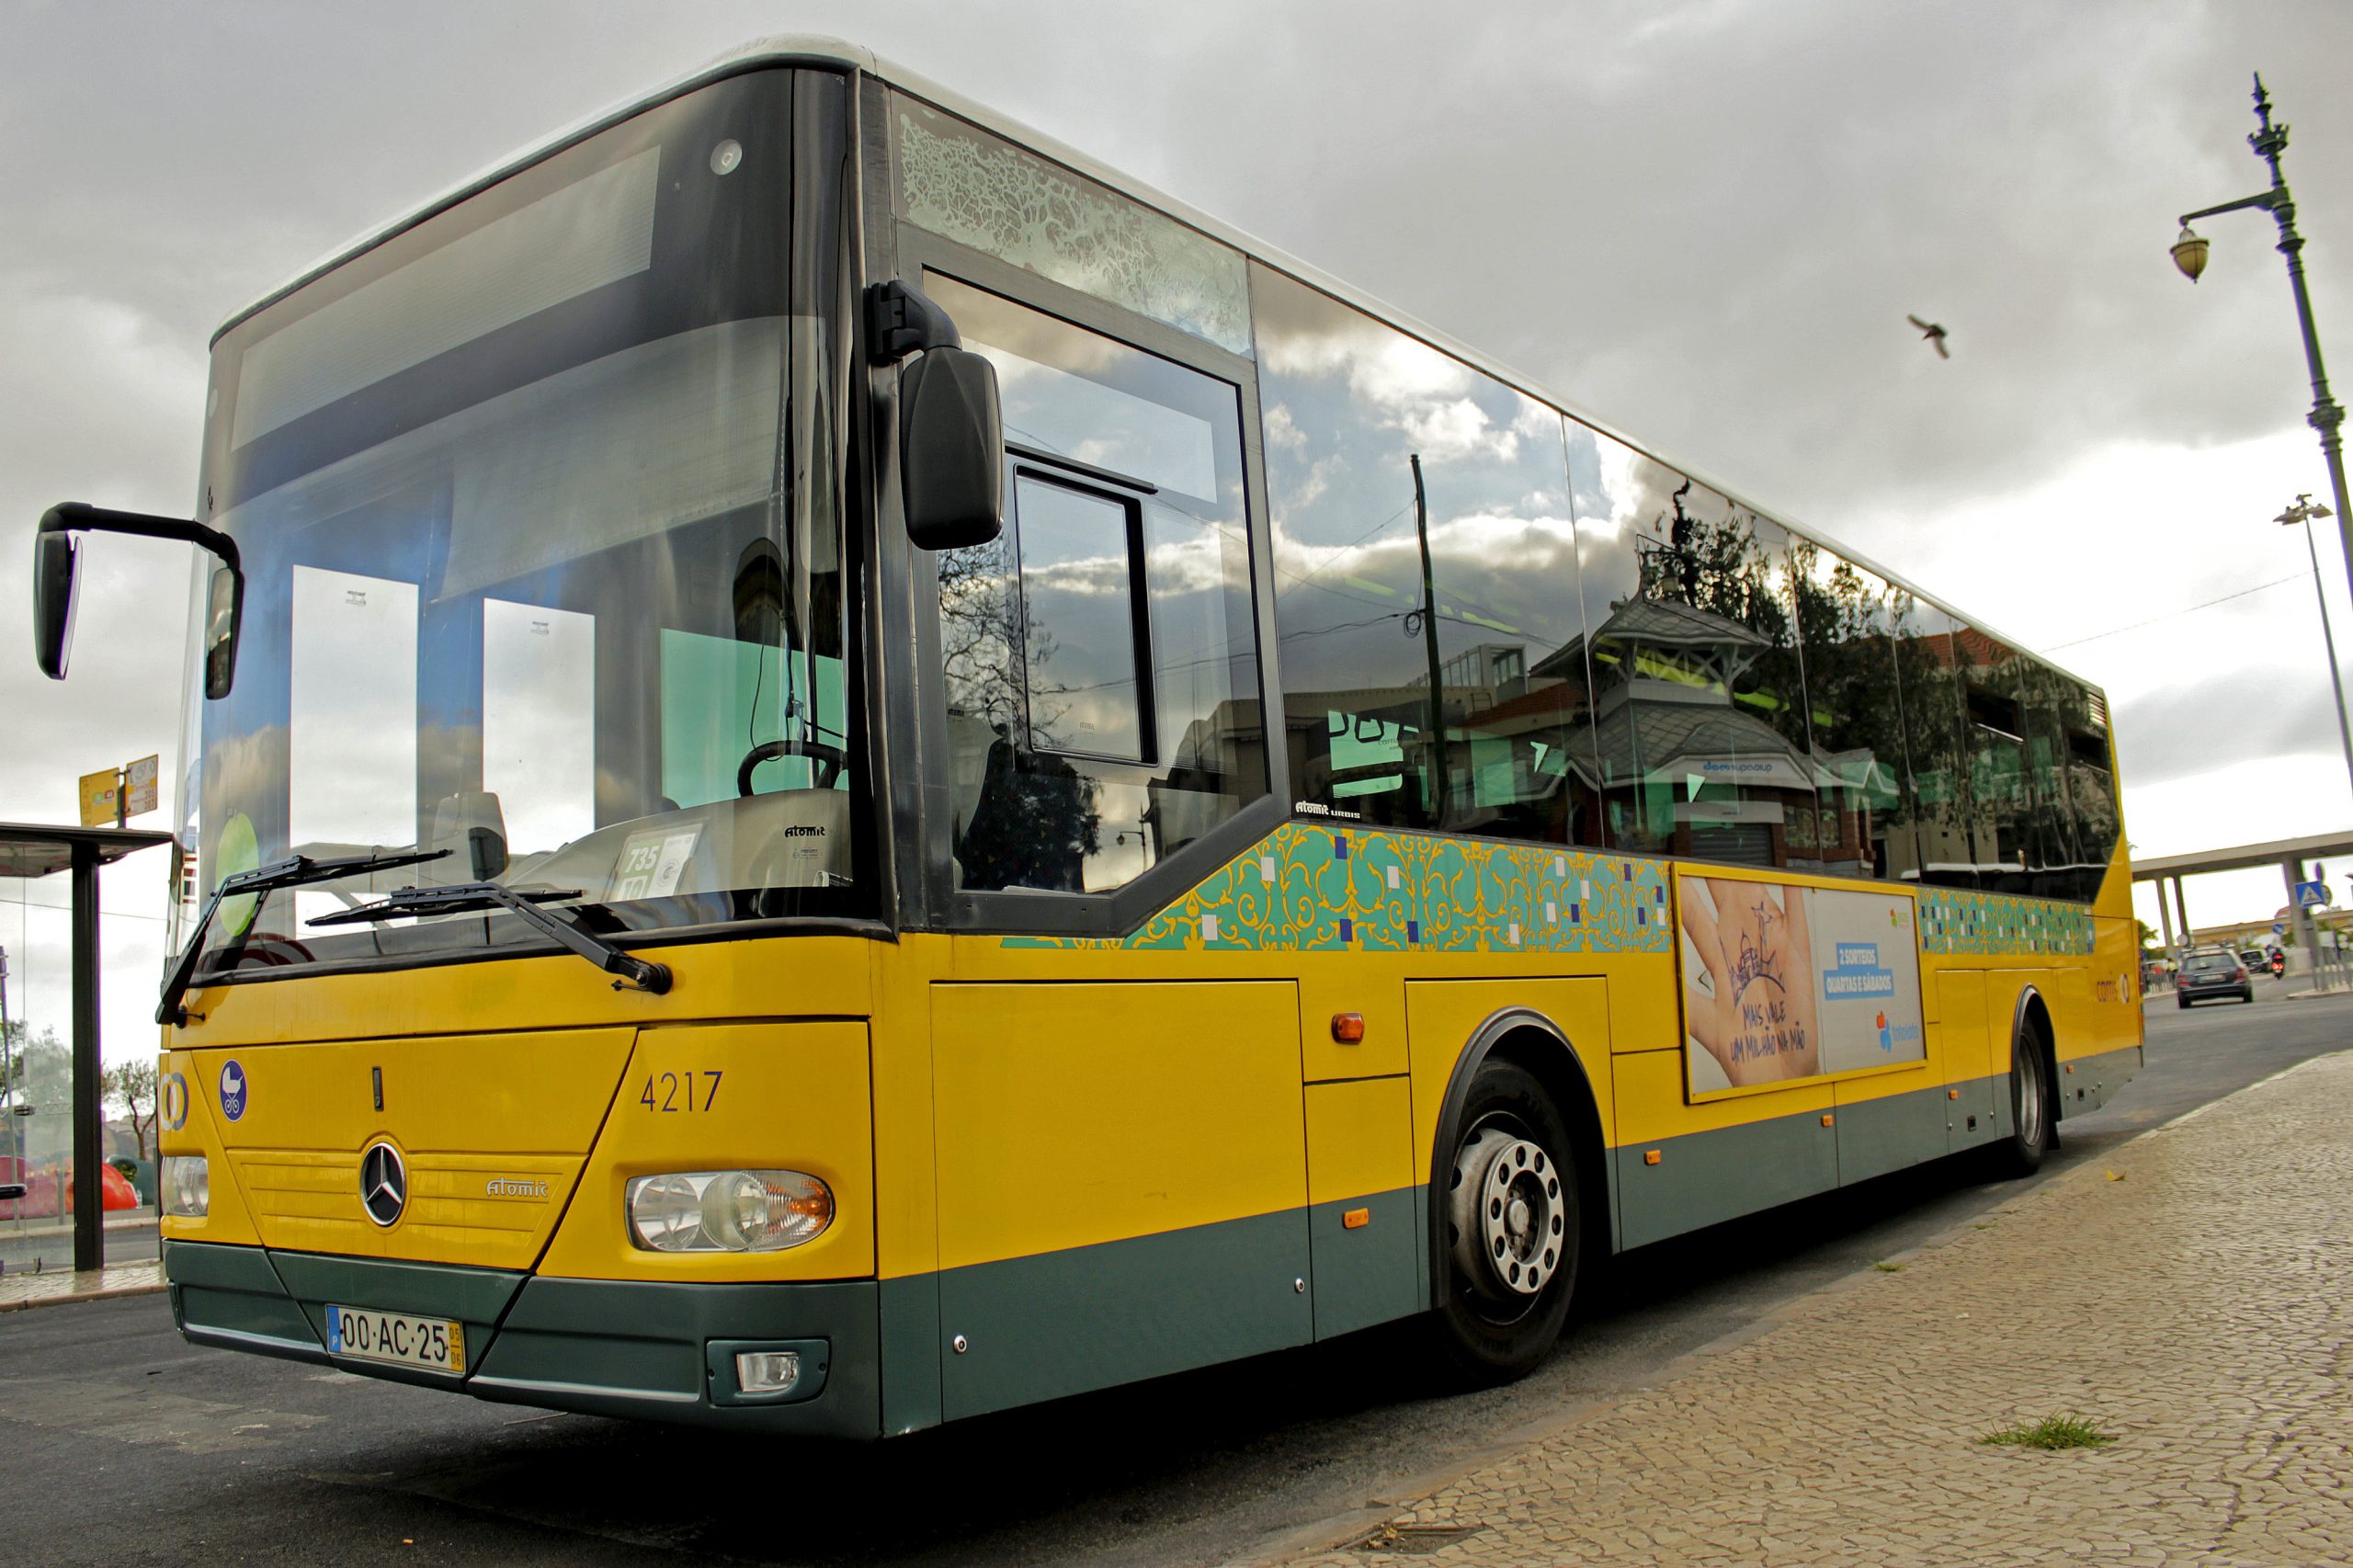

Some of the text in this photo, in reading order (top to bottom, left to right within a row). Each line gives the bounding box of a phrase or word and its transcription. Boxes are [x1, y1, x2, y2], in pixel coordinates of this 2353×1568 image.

[1295, 801, 1361, 819] Atomic URBIS
[784, 824, 826, 837] Atomic
[626, 845, 660, 872] 735
[1839, 949, 1876, 965] 2 SORTEIOS
[1826, 976, 1857, 994] QUARTAS
[1862, 971, 1892, 992] SÁBADOS
[1743, 1000, 1787, 1030] MAIS VALE
[1730, 1021, 1805, 1065] UM MILHÃO NA MÃO
[640, 1071, 724, 1112] 4217
[486, 1176, 549, 1198] Atomic
[332, 1335, 338, 1346] P
[449, 1327, 460, 1341] 05
